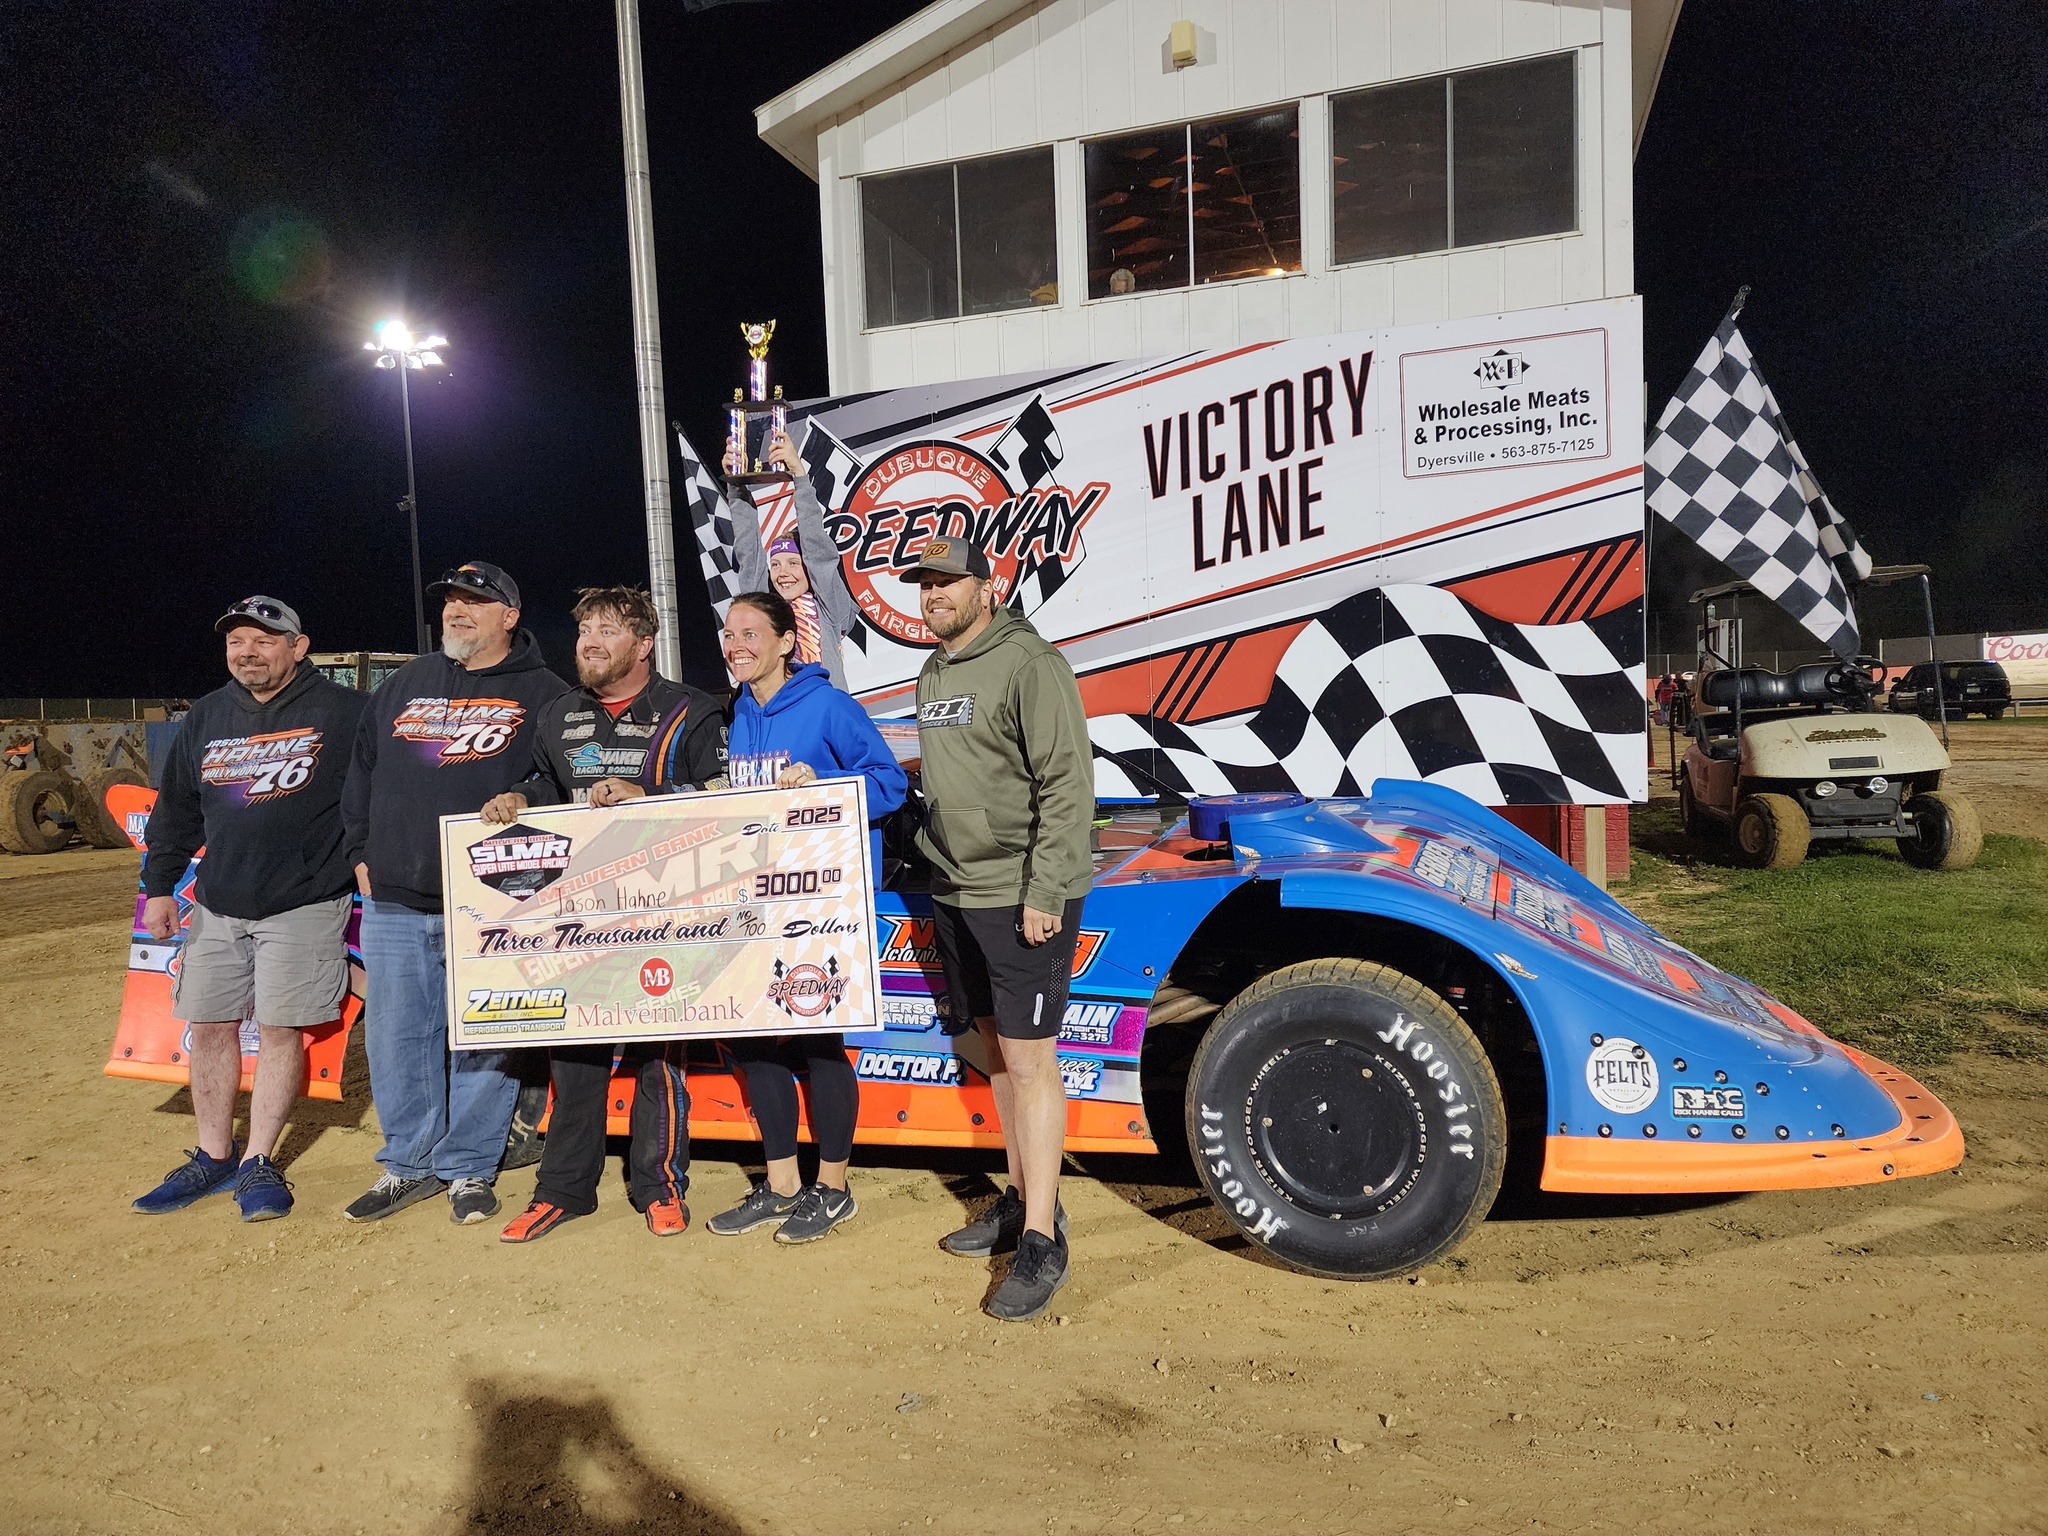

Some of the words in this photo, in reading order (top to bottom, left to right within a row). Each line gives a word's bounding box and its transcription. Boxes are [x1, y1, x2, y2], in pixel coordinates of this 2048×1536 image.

[1418, 396, 1521, 422] Wholesale
[1528, 387, 1590, 411] Meats
[1142, 351, 1374, 500] VICTORY
[1414, 428, 1428, 445] &
[1435, 416, 1553, 444] Processing,
[1559, 409, 1599, 429] Inc.
[1417, 450, 1485, 470] Dyersville
[1501, 437, 1595, 461] 563-875-7125
[863, 449, 992, 499] DUBUQUE
[823, 488, 1102, 570] PEEDWAY
[1192, 457, 1325, 572] LANE
[1987, 636, 2048, 661] Coo
[401, 705, 521, 720] HAHNE
[407, 697, 449, 706] JASON
[205, 737, 250, 749] JASON
[397, 722, 459, 736] HOLLYWOOD
[443, 724, 513, 755] 76
[202, 735, 319, 765] HAHNE
[203, 765, 260, 780] HOLLYWOOD
[248, 756, 315, 794] 76
[575, 765, 606, 775] RACING
[606, 766, 640, 775] BODIES
[741, 822, 781, 836] Date
[786, 805, 843, 827] 2025
[471, 840, 569, 864] SLMR
[482, 836, 528, 847] MALVERN
[529, 834, 556, 843] BANK
[472, 862, 498, 877] SUPER
[498, 860, 516, 872] LATE
[516, 859, 542, 871] MODEL
[542, 857, 570, 869] RACING
[538, 850, 648, 905] MALVERN
[652, 821, 723, 861] BANK
[1414, 840, 1455, 888] GERBER
[508, 888, 536, 897] SERIES
[554, 887, 606, 917] Jason
[617, 885, 666, 911] Hahne
[738, 889, 748, 904] $
[456, 905, 476, 916] Pay
[479, 928, 545, 955] Three
[554, 923, 672, 950] Thousand
[675, 918, 729, 940] and
[782, 918, 861, 939] Dollars
[643, 968, 670, 988] MB
[768, 978, 849, 997] SPEEDWAY
[464, 989, 565, 1018] ZEITNER
[576, 996, 744, 1029] Malvern.bank
[882, 1002, 950, 1016] DERSON
[1062, 1003, 1118, 1027] AIN
[464, 1025, 519, 1036] REFRIGERATED
[521, 1022, 565, 1033] TRANSPORT
[883, 1013, 931, 1026] ARMS
[1056, 1031, 1108, 1042] 97-3275
[859, 1054, 939, 1080] DOCTOR
[942, 1058, 962, 1081] P.
[1058, 1059, 1099, 1078] ARRY
[1250, 1048, 1291, 1092] WHEELS
[1374, 1053, 1416, 1098] KEIZER
[1593, 1060, 1651, 1089] FELTS
[1376, 1012, 1475, 1160] Hoosier
[1673, 1088, 1743, 1110] RHC
[1245, 1096, 1257, 1157] FORGED
[1413, 1101, 1428, 1164] FORGED
[1200, 1102, 1290, 1244] Hoosier
[1254, 1157, 1294, 1203] KEIZER
[1377, 1168, 1421, 1213] WHEELS
